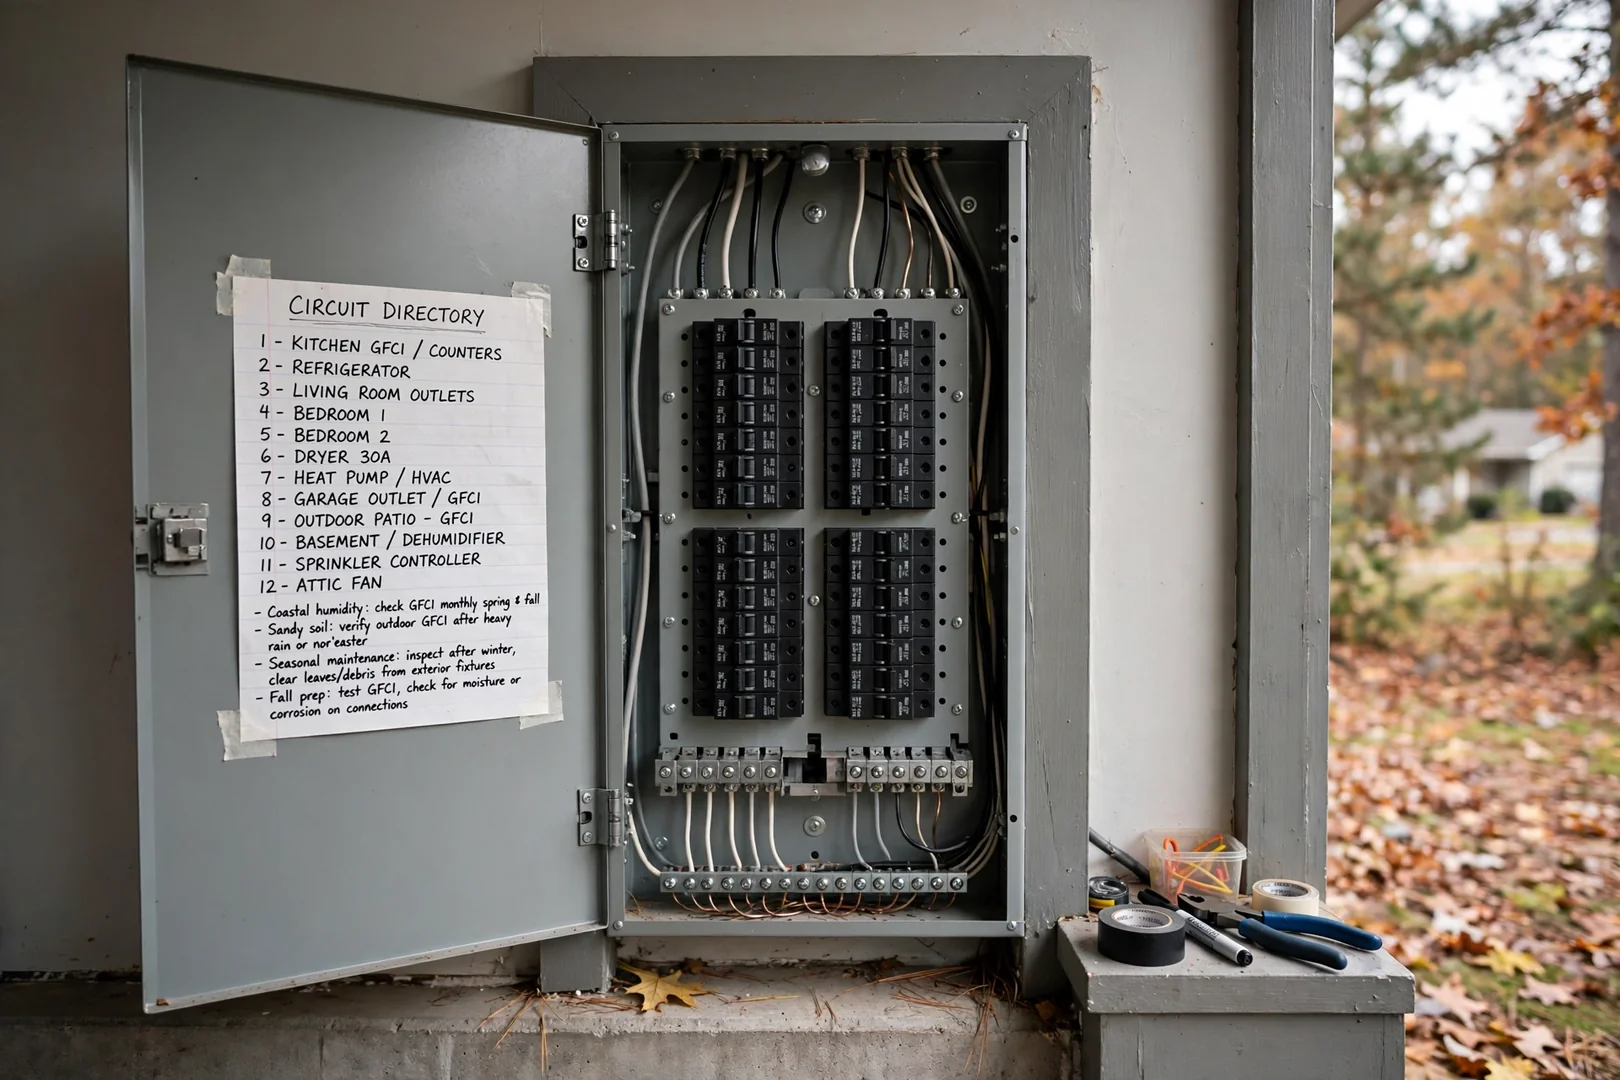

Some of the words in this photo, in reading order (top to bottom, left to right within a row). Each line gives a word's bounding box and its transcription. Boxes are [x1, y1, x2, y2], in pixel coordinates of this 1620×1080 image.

[289, 295, 370, 318] CIRCUIT
[383, 301, 485, 327] DIRECTORY
[261, 333, 265, 348] 1
[292, 335, 361, 353] KITCHEN
[370, 340, 405, 355] GFCI
[412, 339, 424, 360] /
[429, 344, 502, 361] COUNTERS
[259, 357, 270, 372] 2
[292, 359, 411, 379] REFRIGERATOR
[259, 381, 270, 397] 3
[293, 382, 348, 400] LIVING
[359, 385, 401, 401] ROOM
[410, 388, 475, 403] OUTLETS
[259, 404, 270, 419] 4
[294, 405, 370, 422] BEDROOM
[381, 409, 385, 422] 1
[260, 427, 271, 441] 5
[294, 427, 370, 443] BEDROOM
[379, 430, 391, 443] 2
[261, 448, 272, 463] 6
[295, 449, 349, 465] DRYER
[360, 450, 391, 464] 30A
[260, 470, 272, 485] 7
[294, 469, 337, 485] HEAT
[346, 470, 389, 485] PUMP
[395, 466, 406, 488] /
[412, 470, 451, 485] HVAC
[262, 491, 272, 507] 8
[294, 491, 359, 507] GARAGE
[368, 491, 427, 506] OUTLET
[431, 487, 442, 509] /
[447, 491, 480, 505] GFCI
[261, 513, 271, 528] 9
[294, 513, 365, 528] OUTDOOR
[374, 512, 416, 526] PATIO
[440, 511, 473, 526] GFCI
[260, 536, 276, 550] 10
[296, 534, 380, 550] BASEMENT
[386, 529, 397, 551] /
[402, 531, 506, 547] DEHUMIDIFIER
[261, 558, 271, 572] 11
[295, 555, 382, 572] SPRINKLER
[390, 552, 481, 569] CONTROLLER
[260, 579, 277, 594] 12
[296, 577, 342, 593] ATTIC
[352, 575, 382, 590] FAN
[267, 603, 310, 618] Coastal
[316, 601, 369, 620] humidity:
[374, 599, 404, 613] check
[409, 599, 435, 611] GFCI
[440, 596, 478, 614] monthly
[482, 596, 510, 612] spring
[524, 592, 540, 605] fall
[268, 621, 304, 639] Sandy
[309, 619, 333, 634] soil:
[339, 617, 371, 636] verify
[376, 615, 417, 630] outdoor
[421, 615, 447, 627] GFCI
[453, 612, 479, 625] after
[483, 611, 512, 628] heavy
[268, 640, 291, 651] rain
[296, 642, 308, 650] or
[313, 634, 368, 649] nor'easter
[269, 653, 320, 670] Seasonal
[327, 651, 400, 666] maintenance:
[406, 646, 444, 665] inspect
[449, 644, 476, 658] after
[481, 643, 516, 656] winter,
[268, 672, 298, 686] clear
[304, 666, 375, 684] leaves/debris
[381, 664, 406, 677] from
[411, 663, 451, 675] exterior
[455, 658, 495, 672] fixtures
[270, 689, 292, 704] Fall
[300, 690, 330, 709] prep:
[338, 684, 362, 698] test
[367, 682, 401, 696] GFCI,
[406, 679, 436, 693] check
[441, 677, 458, 690] for
[462, 675, 505, 688] moisture
[510, 676, 522, 685] or
[269, 705, 321, 720] corrosion
[327, 707, 340, 715] on
[346, 698, 408, 714] connections
